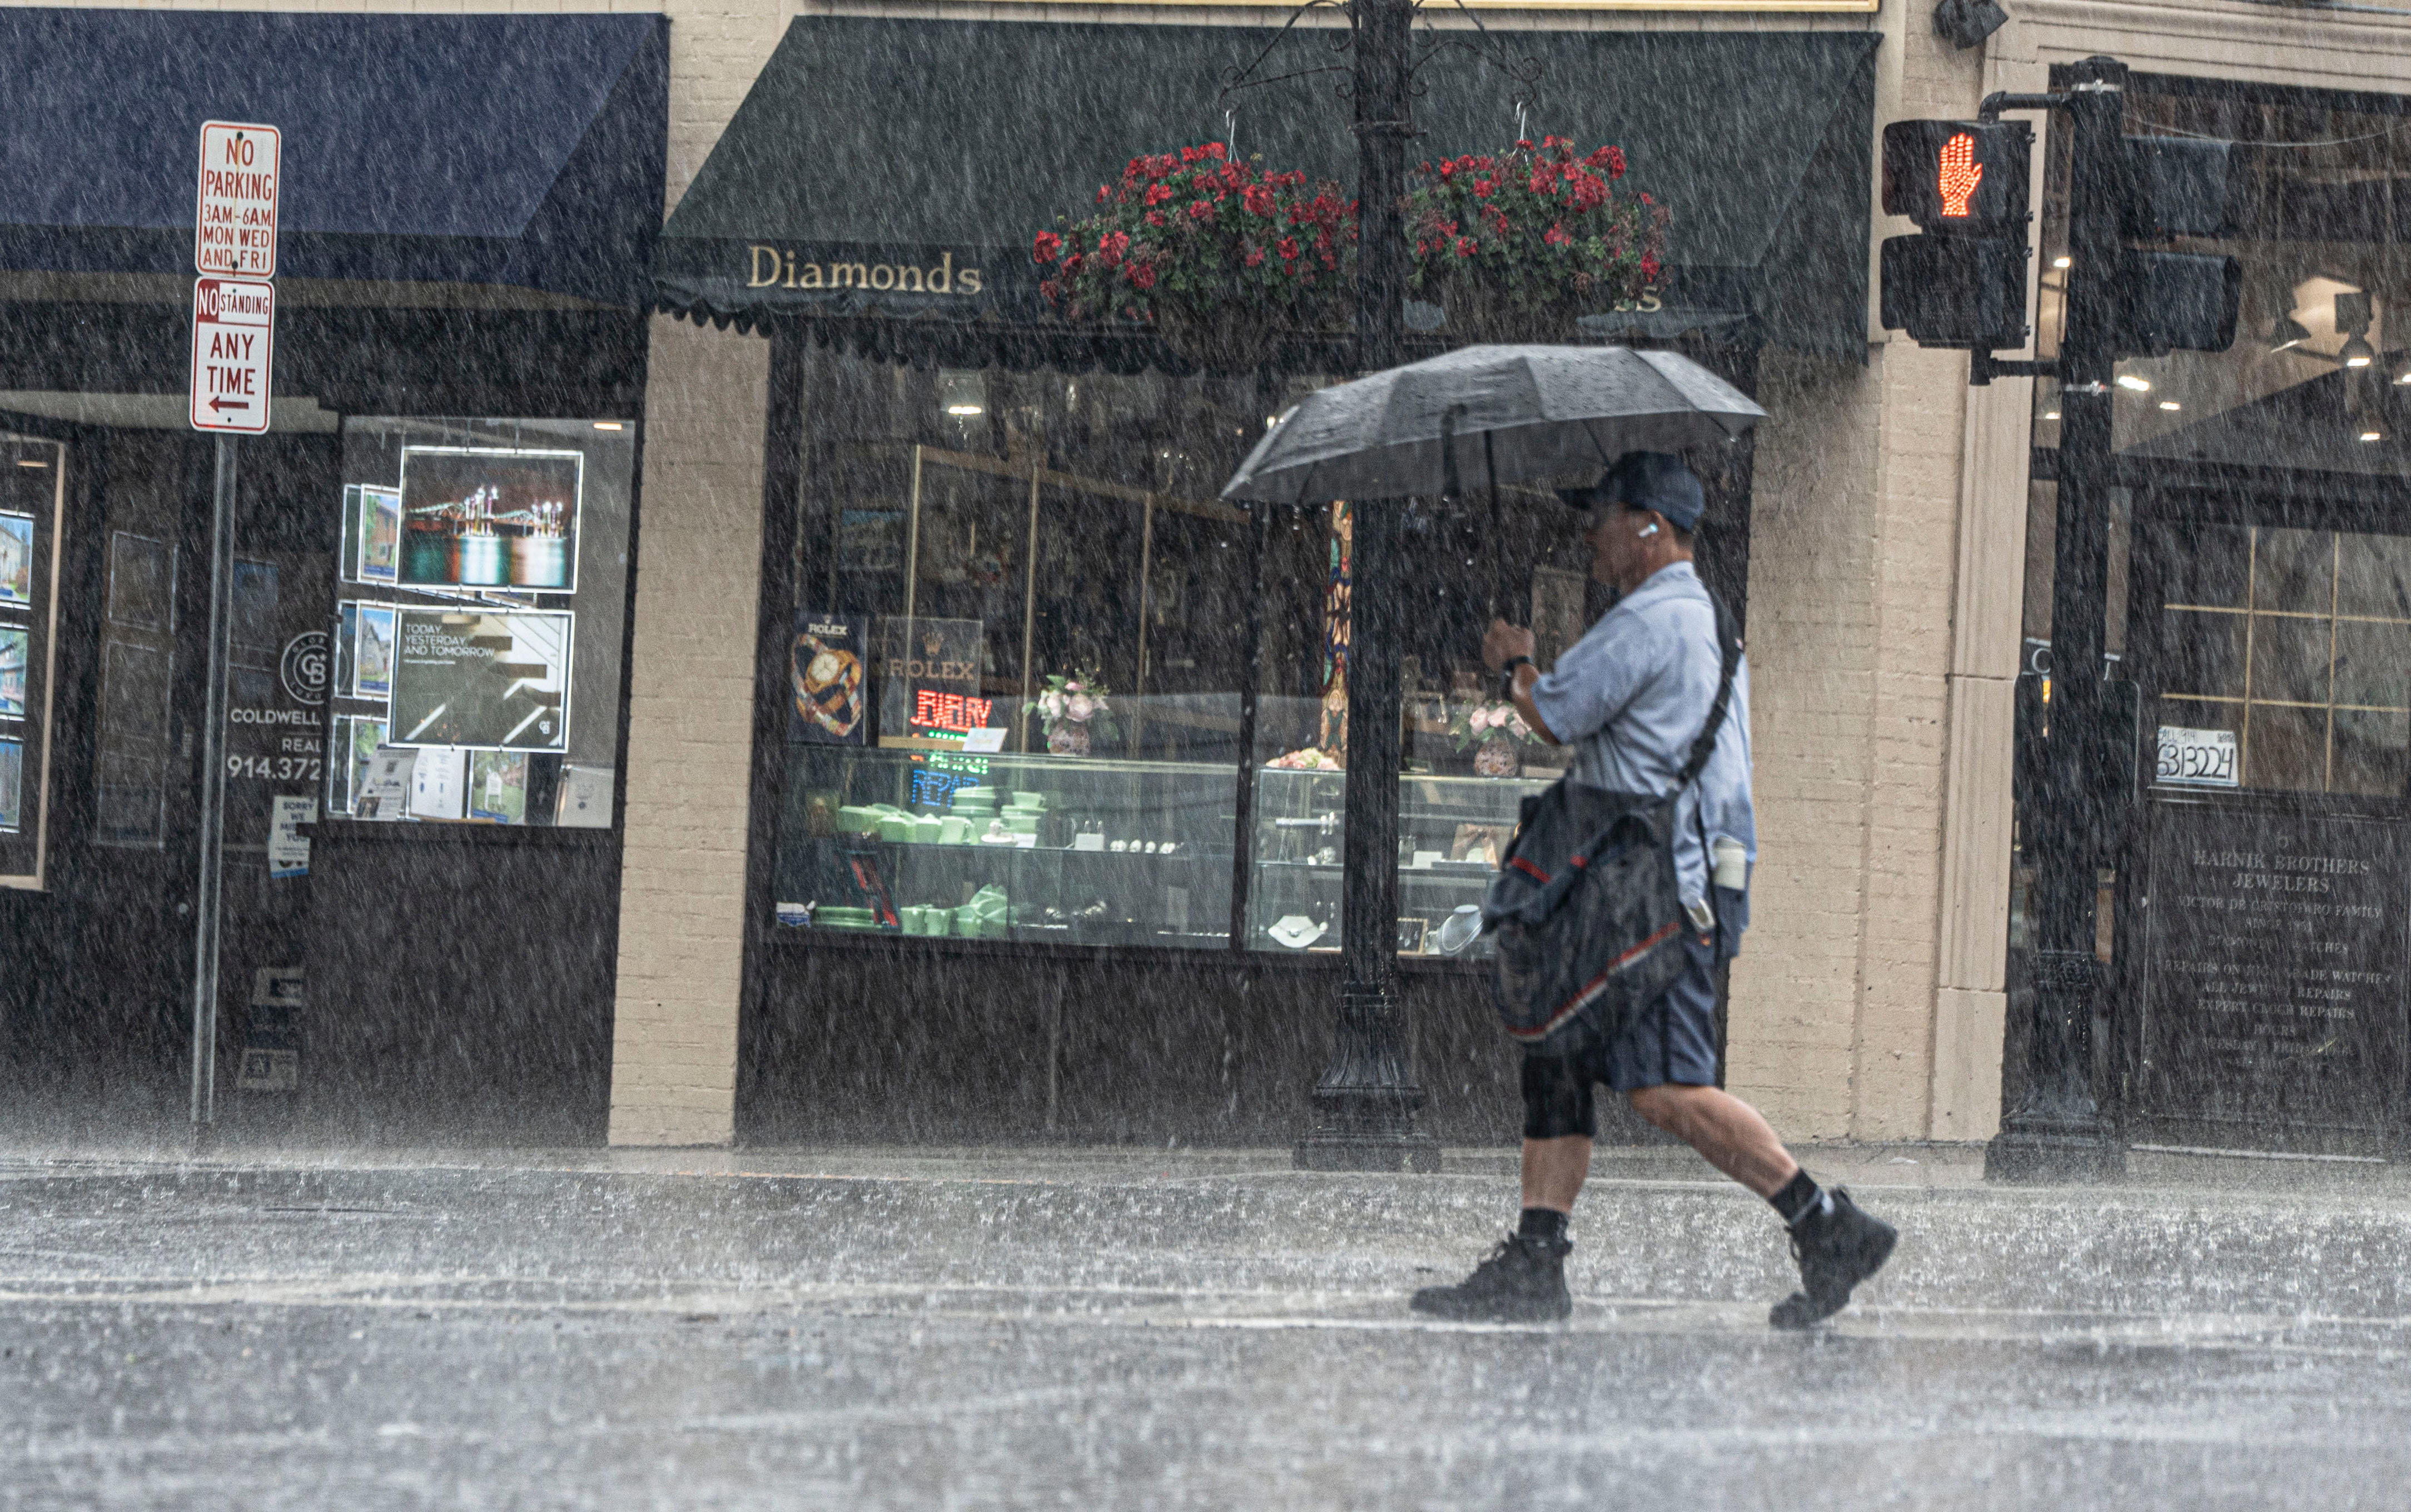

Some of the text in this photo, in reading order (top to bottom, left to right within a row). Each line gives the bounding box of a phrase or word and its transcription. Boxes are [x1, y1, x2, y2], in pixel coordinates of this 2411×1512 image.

[226, 138, 253, 166] NO
[206, 170, 272, 201] PARKING
[203, 226, 270, 247] MON WED
[203, 248, 266, 270] AND FRI
[747, 245, 982, 294] Diamonds
[198, 288, 269, 316] NO STANDING
[210, 332, 254, 360] ANY
[207, 366, 255, 395] TIME
[808, 622, 848, 636] ROLEX
[404, 645, 495, 658] AND TOMORROW
[889, 658, 975, 680] ROLEX
[230, 708, 321, 726] COLDWELL
[282, 738, 321, 753] REAL
[2157, 744, 2233, 779] 6313224
[2274, 855, 2369, 875] BROTHERS
[2232, 873, 2330, 893] JEWELERS
